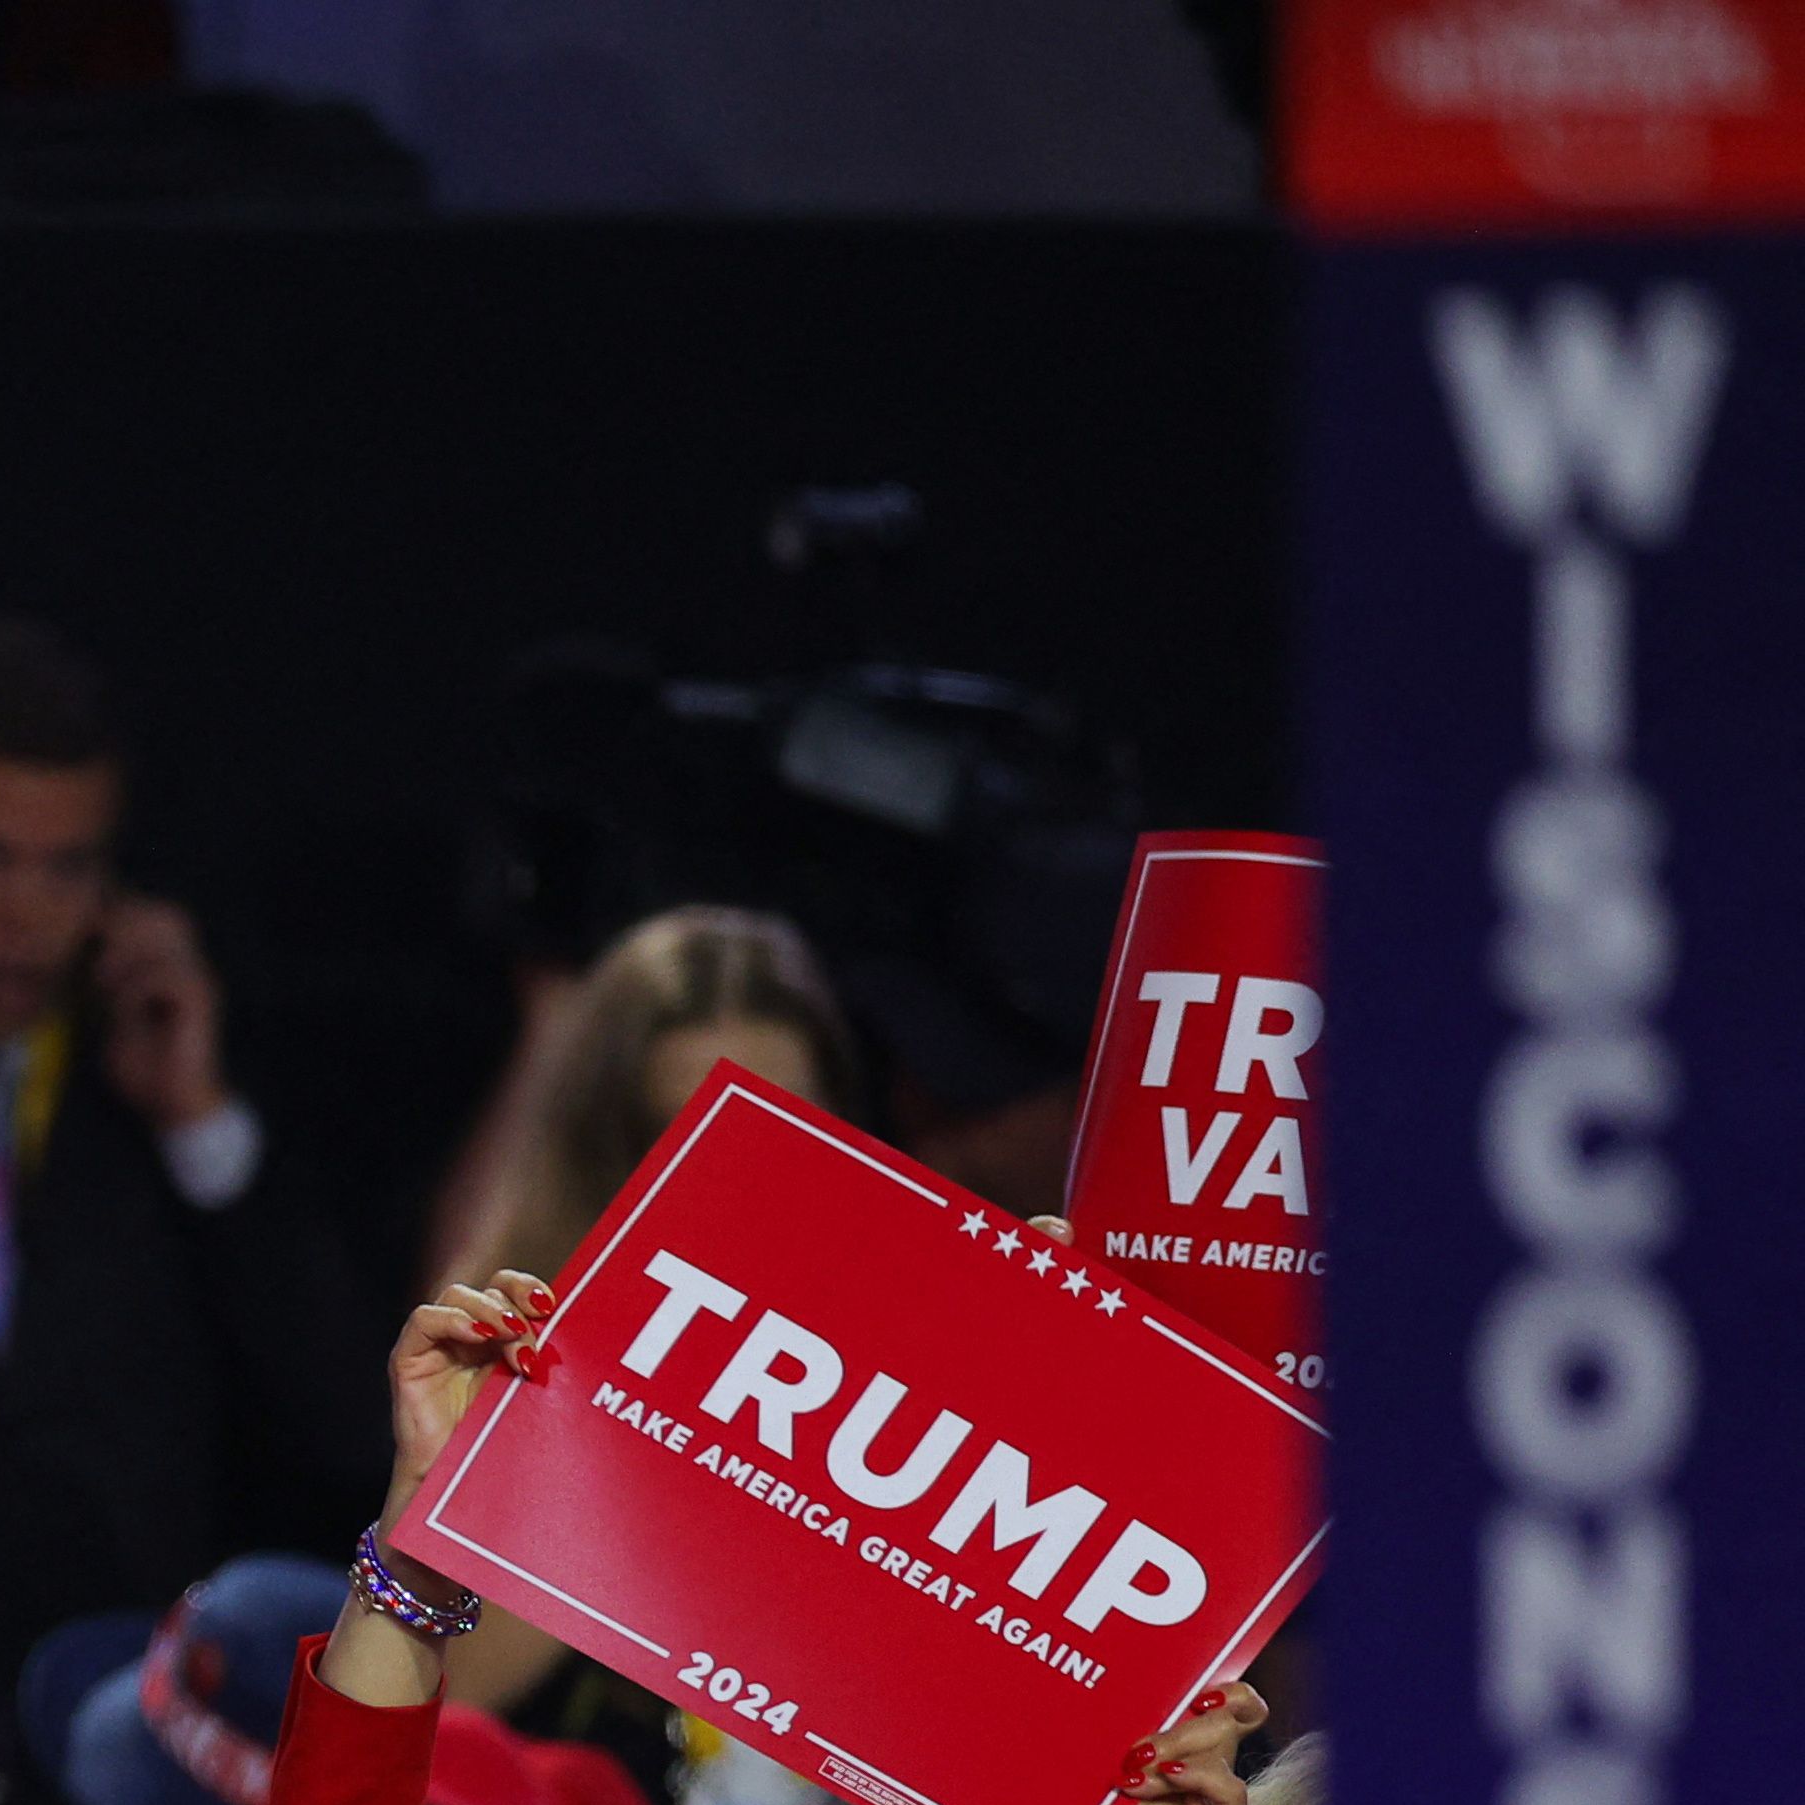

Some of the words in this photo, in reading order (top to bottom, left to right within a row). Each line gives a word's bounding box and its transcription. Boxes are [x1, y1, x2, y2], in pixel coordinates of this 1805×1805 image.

[1105, 1231, 1193, 1266] MAKE
[1201, 1239, 1328, 1277] AMERIC
[591, 1381, 695, 1454] MAKE
[694, 1433, 852, 1547] AMERICA
[857, 1534, 978, 1614] GREAT
[974, 1603, 1108, 1690] AGAIN!
[618, 1248, 1210, 1638] TRUMP
[677, 1648, 800, 1737] 2024
